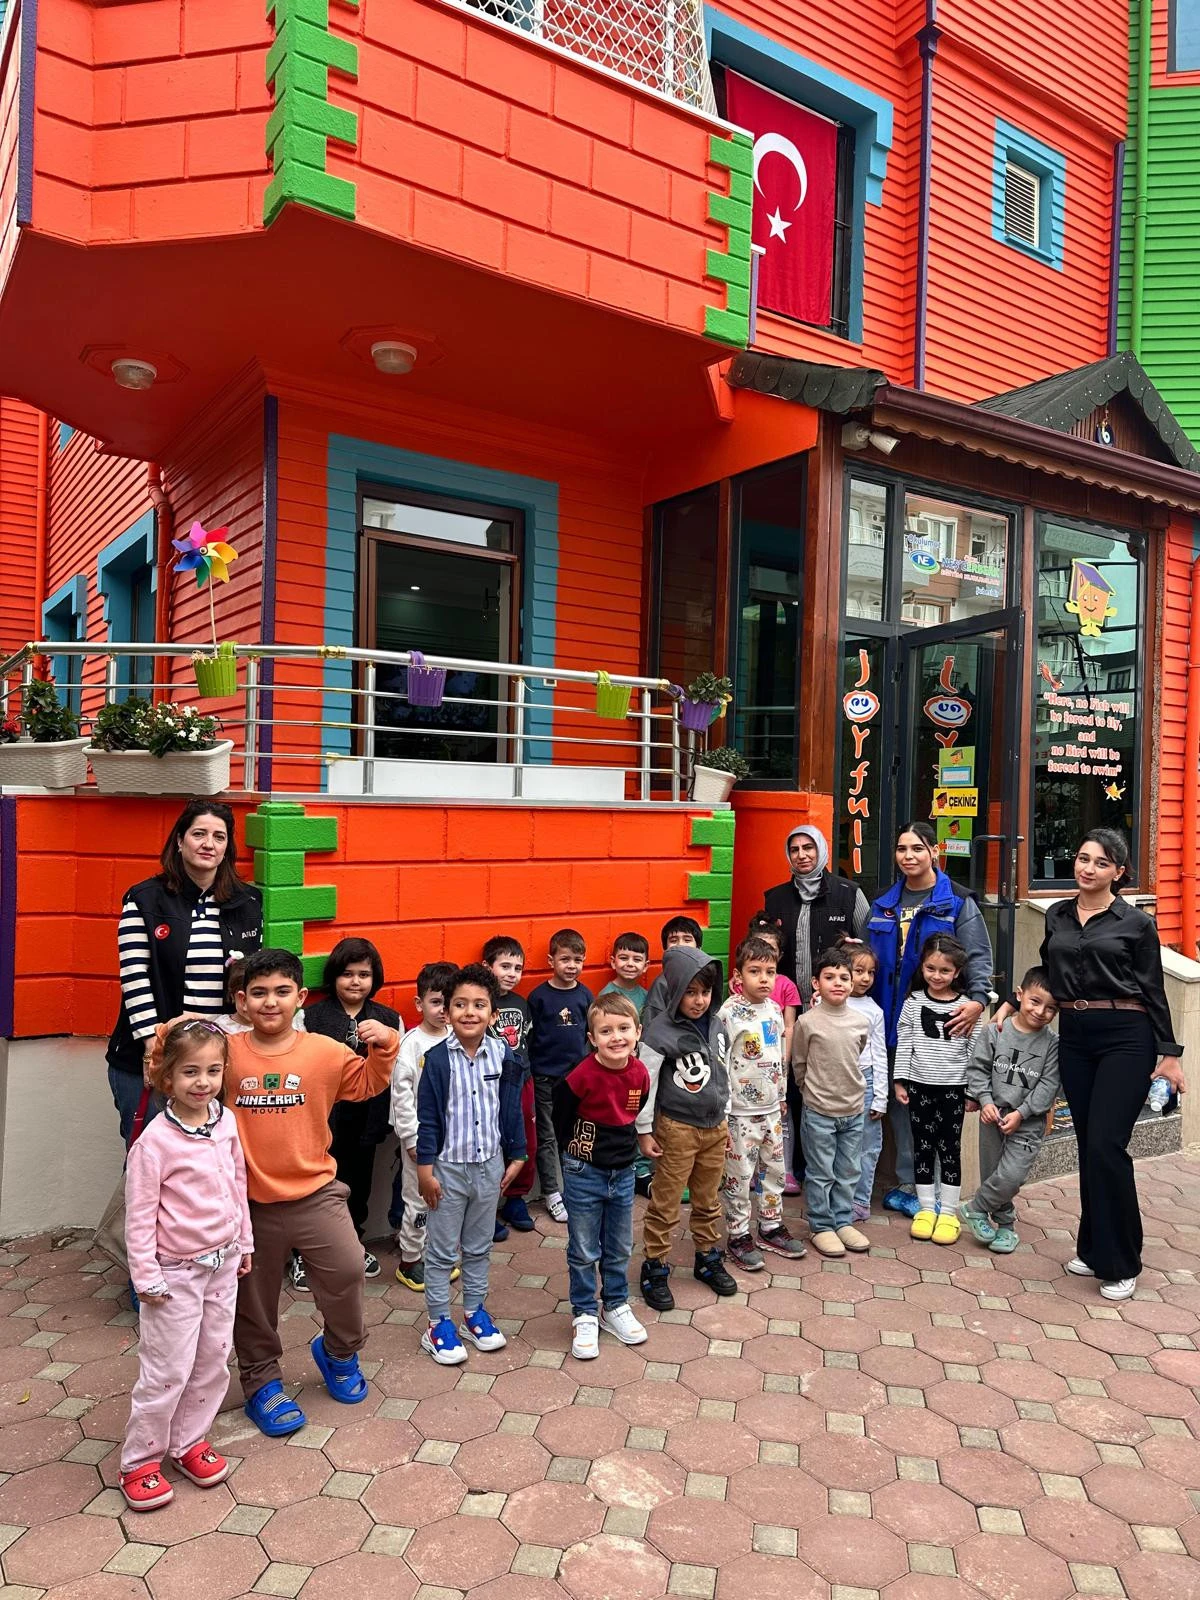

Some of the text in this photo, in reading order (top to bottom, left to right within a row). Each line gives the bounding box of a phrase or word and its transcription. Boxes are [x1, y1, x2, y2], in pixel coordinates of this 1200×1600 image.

[917, 555, 930, 566] NE
[1076, 699, 1088, 708] no
[1090, 697, 1109, 711] Fish
[1111, 702, 1129, 714] will
[1050, 710, 1122, 731] be forced to fly,
[1078, 731, 1096, 742] and
[1051, 746, 1064, 756] no
[1066, 744, 1087, 757] Bird
[1088, 748, 1107, 759] will
[1109, 749, 1120, 760] be
[1048, 760, 1079, 773] forced
[1080, 763, 1091, 774] to
[949, 794, 977, 810] ÇEKİNİZ
[499, 1019, 517, 1028] BULLS
[235, 1093, 306, 1107] MINECRAFT
